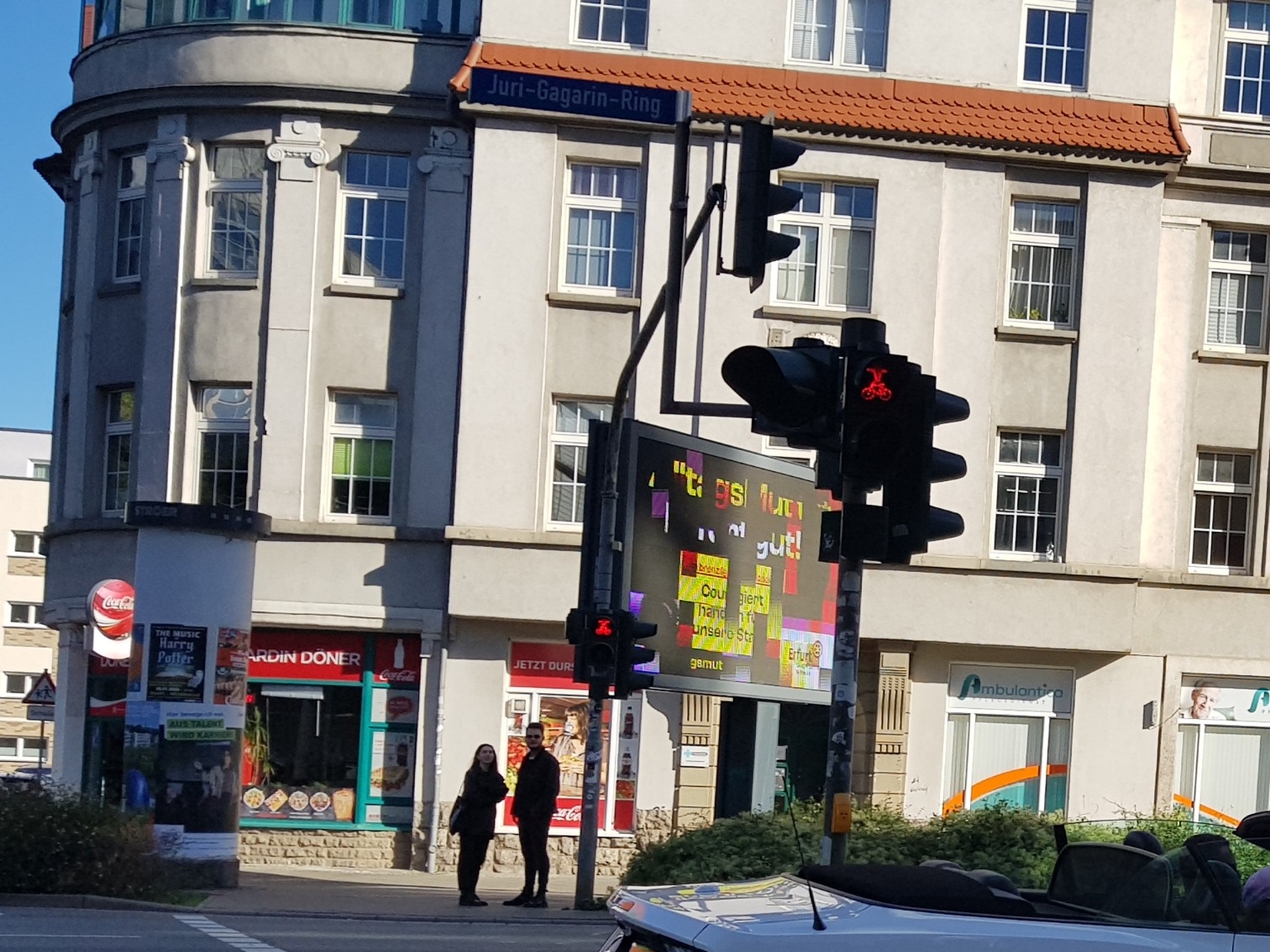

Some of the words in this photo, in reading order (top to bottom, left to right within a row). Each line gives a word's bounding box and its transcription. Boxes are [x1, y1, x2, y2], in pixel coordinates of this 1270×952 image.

[487, 74, 661, 118] Juri-Gagarin-Ring
[155, 629, 171, 637] THE
[172, 630, 201, 639] MUSIC
[159, 637, 194, 654] Harry
[157, 651, 194, 664] Potter
[248, 649, 297, 664] ARDIN
[300, 648, 361, 666] DÖNER
[513, 659, 546, 670] JETZT
[957, 673, 1064, 700] Ambulantica
